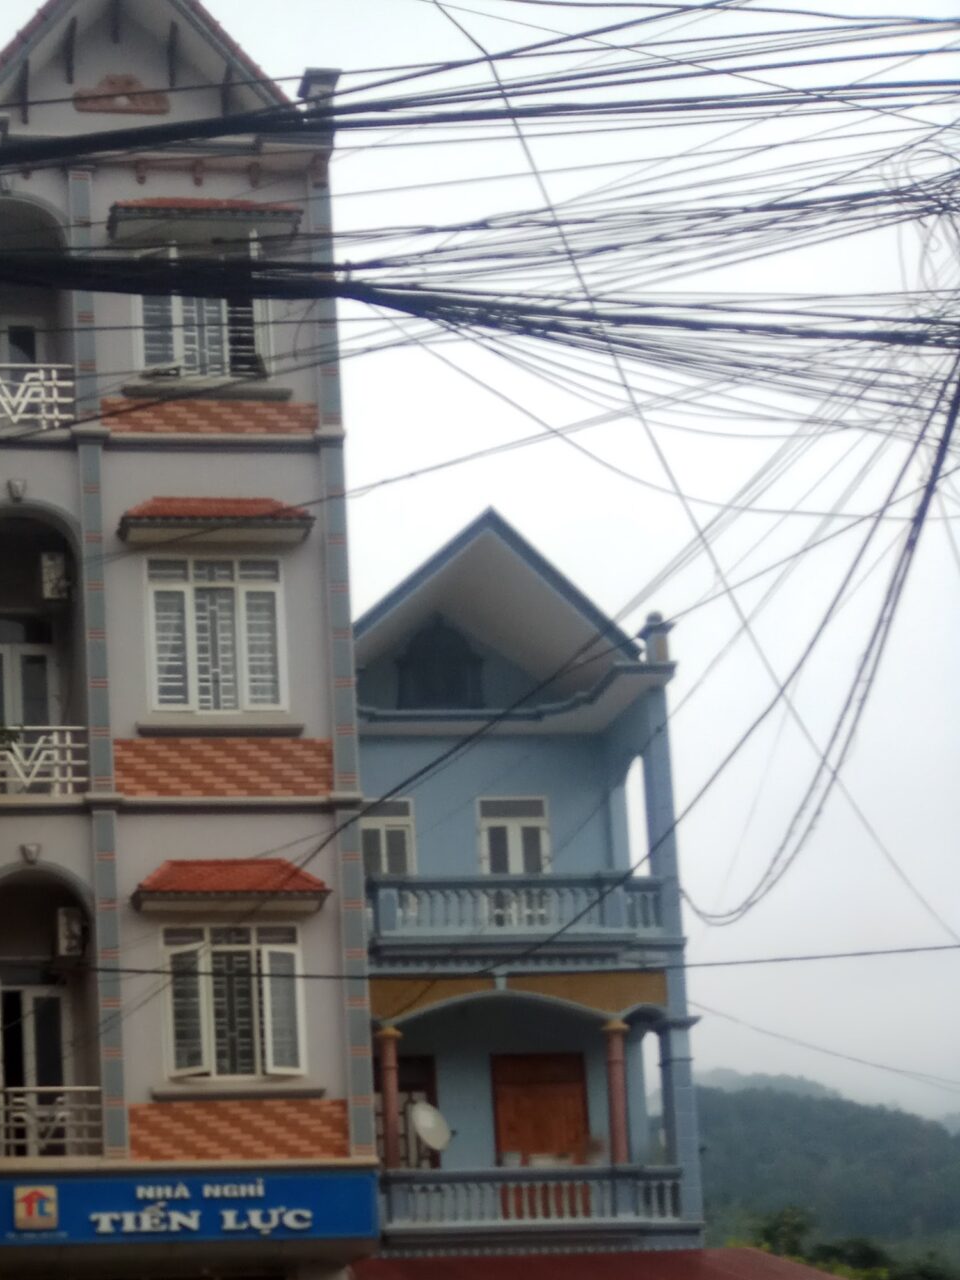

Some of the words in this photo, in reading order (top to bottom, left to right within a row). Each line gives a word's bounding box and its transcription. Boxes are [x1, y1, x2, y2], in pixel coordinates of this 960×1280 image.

[136, 1183, 190, 1199] NHÀ
[203, 1177, 265, 1198] NGHỈ
[220, 1206, 313, 1235] LỰC
